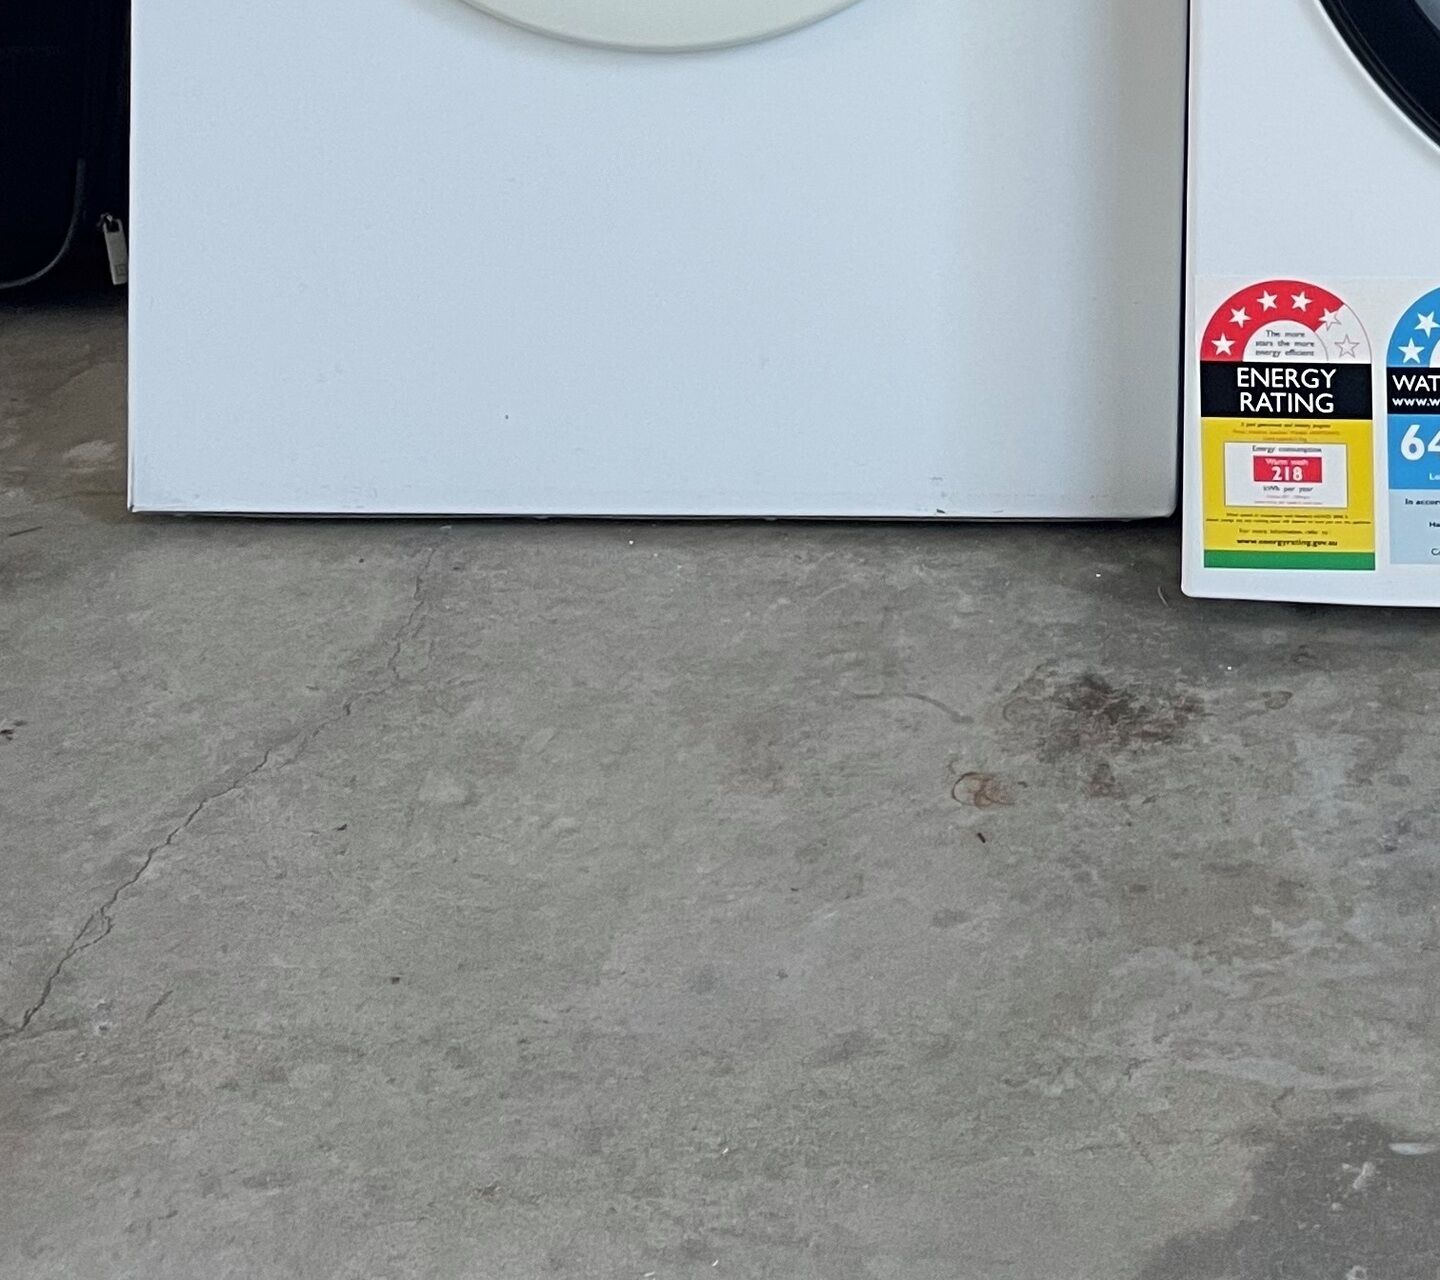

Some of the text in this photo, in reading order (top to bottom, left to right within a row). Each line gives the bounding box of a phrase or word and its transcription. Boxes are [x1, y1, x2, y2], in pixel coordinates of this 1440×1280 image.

[1255, 350, 1281, 358] energy
[1237, 367, 1337, 388] ENERGY
[1240, 392, 1334, 413] RATING
[1252, 445, 1275, 453] Energy
[1271, 466, 1303, 481] 218
